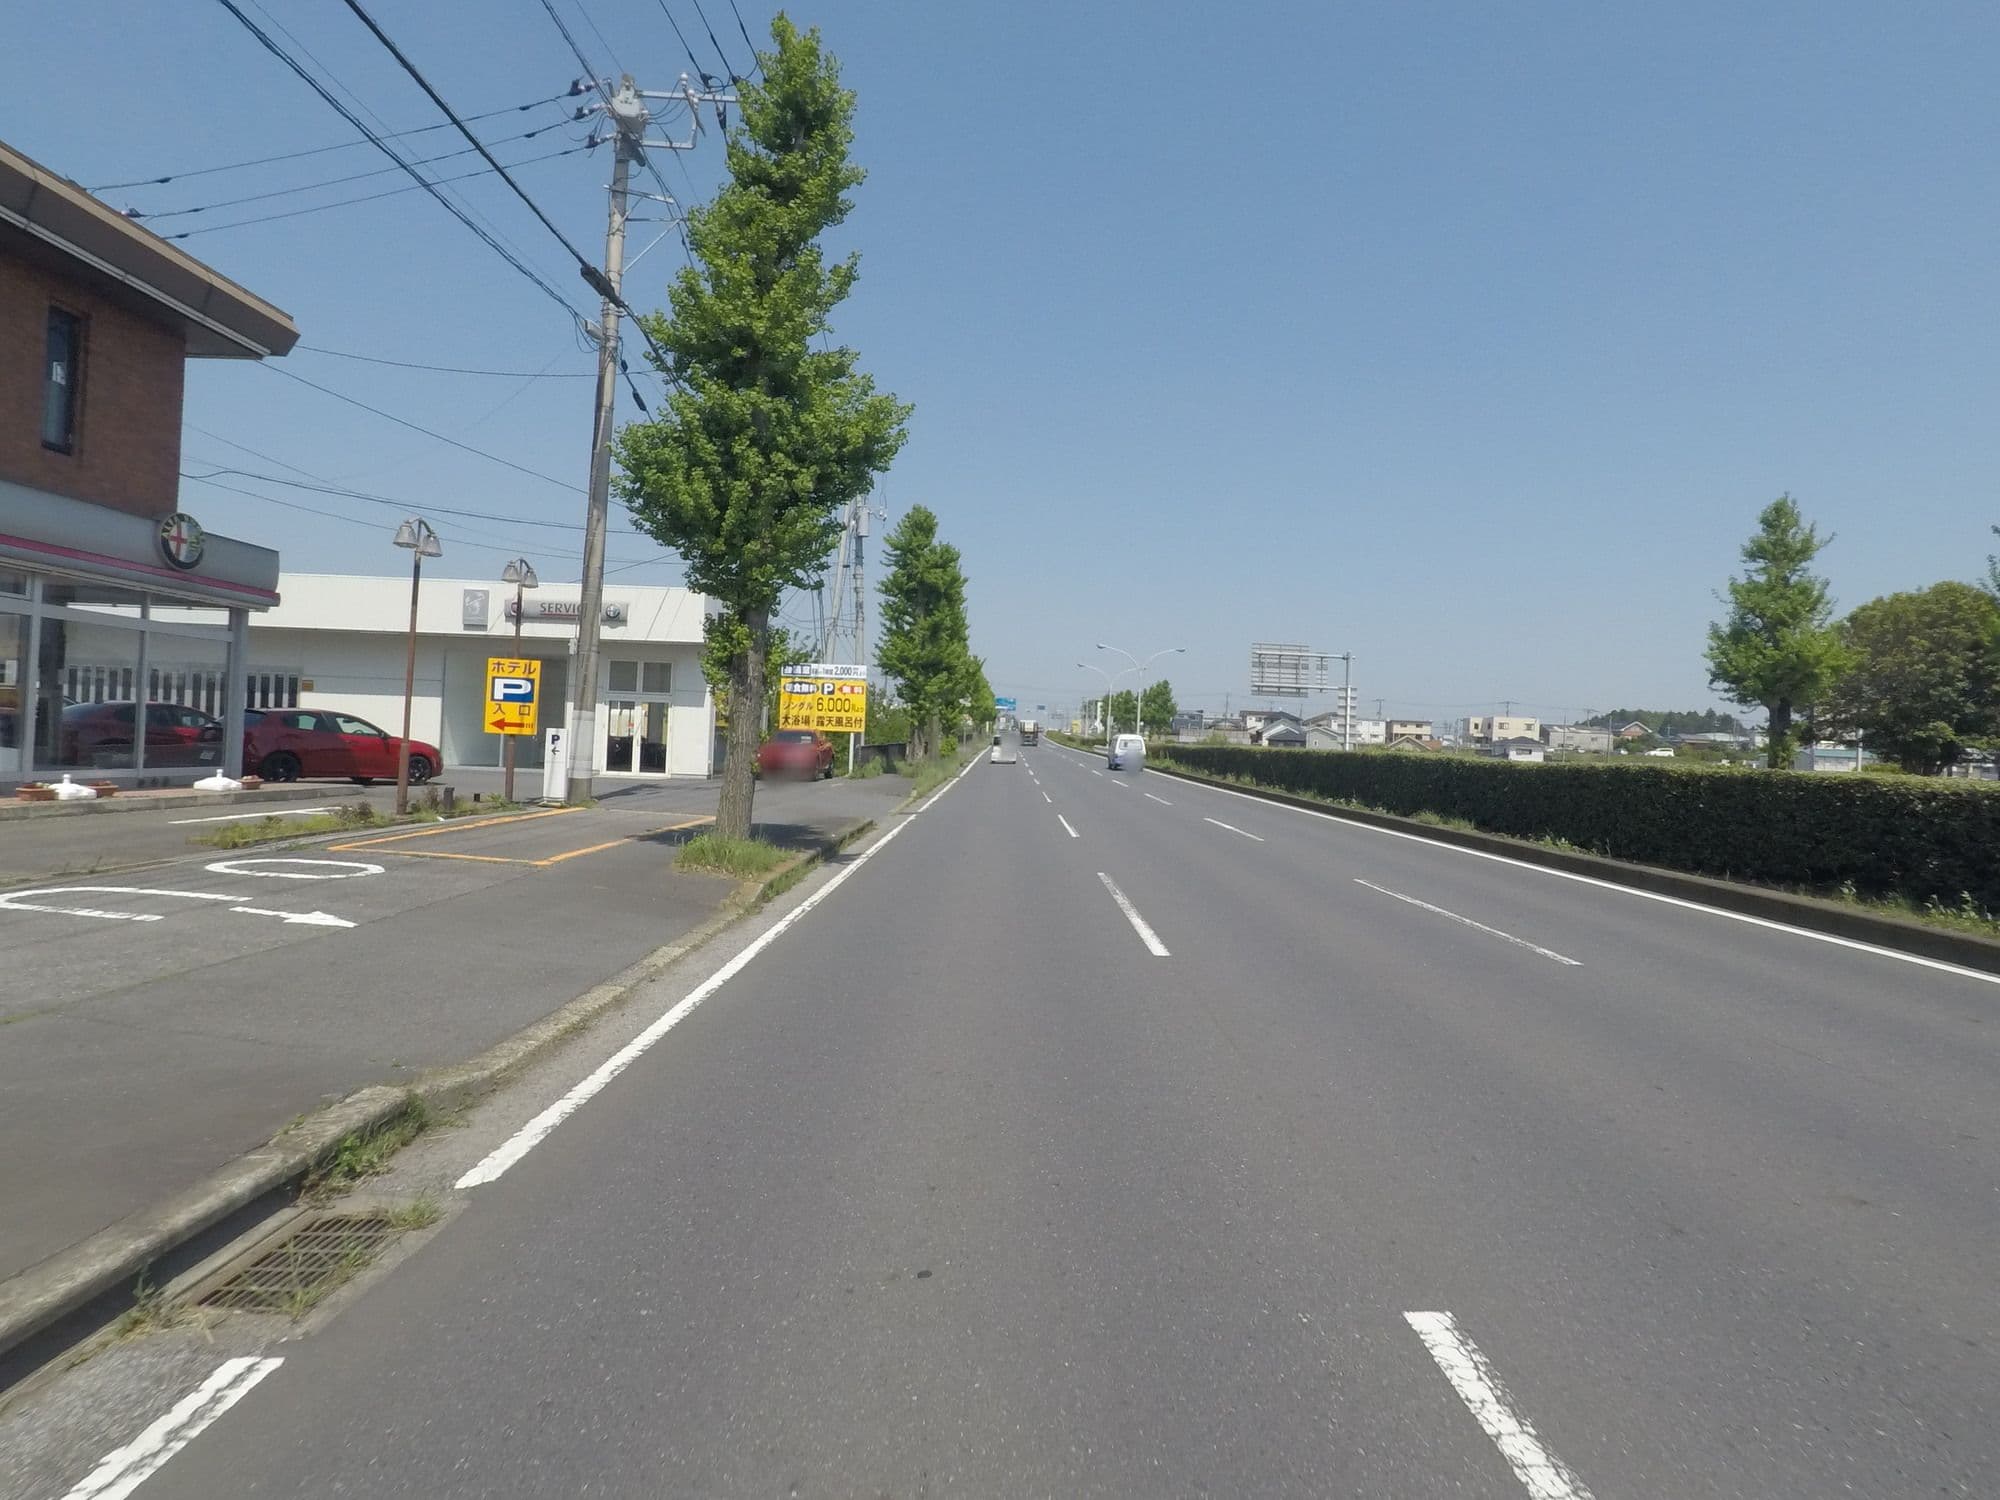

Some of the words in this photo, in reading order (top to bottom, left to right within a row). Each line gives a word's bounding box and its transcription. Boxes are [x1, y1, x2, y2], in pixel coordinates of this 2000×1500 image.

[491, 661, 536, 675] ホテル
[493, 678, 532, 700] P
[823, 684, 834, 695] P
[493, 703, 530, 716] 入口
[551, 734, 560, 745] P
